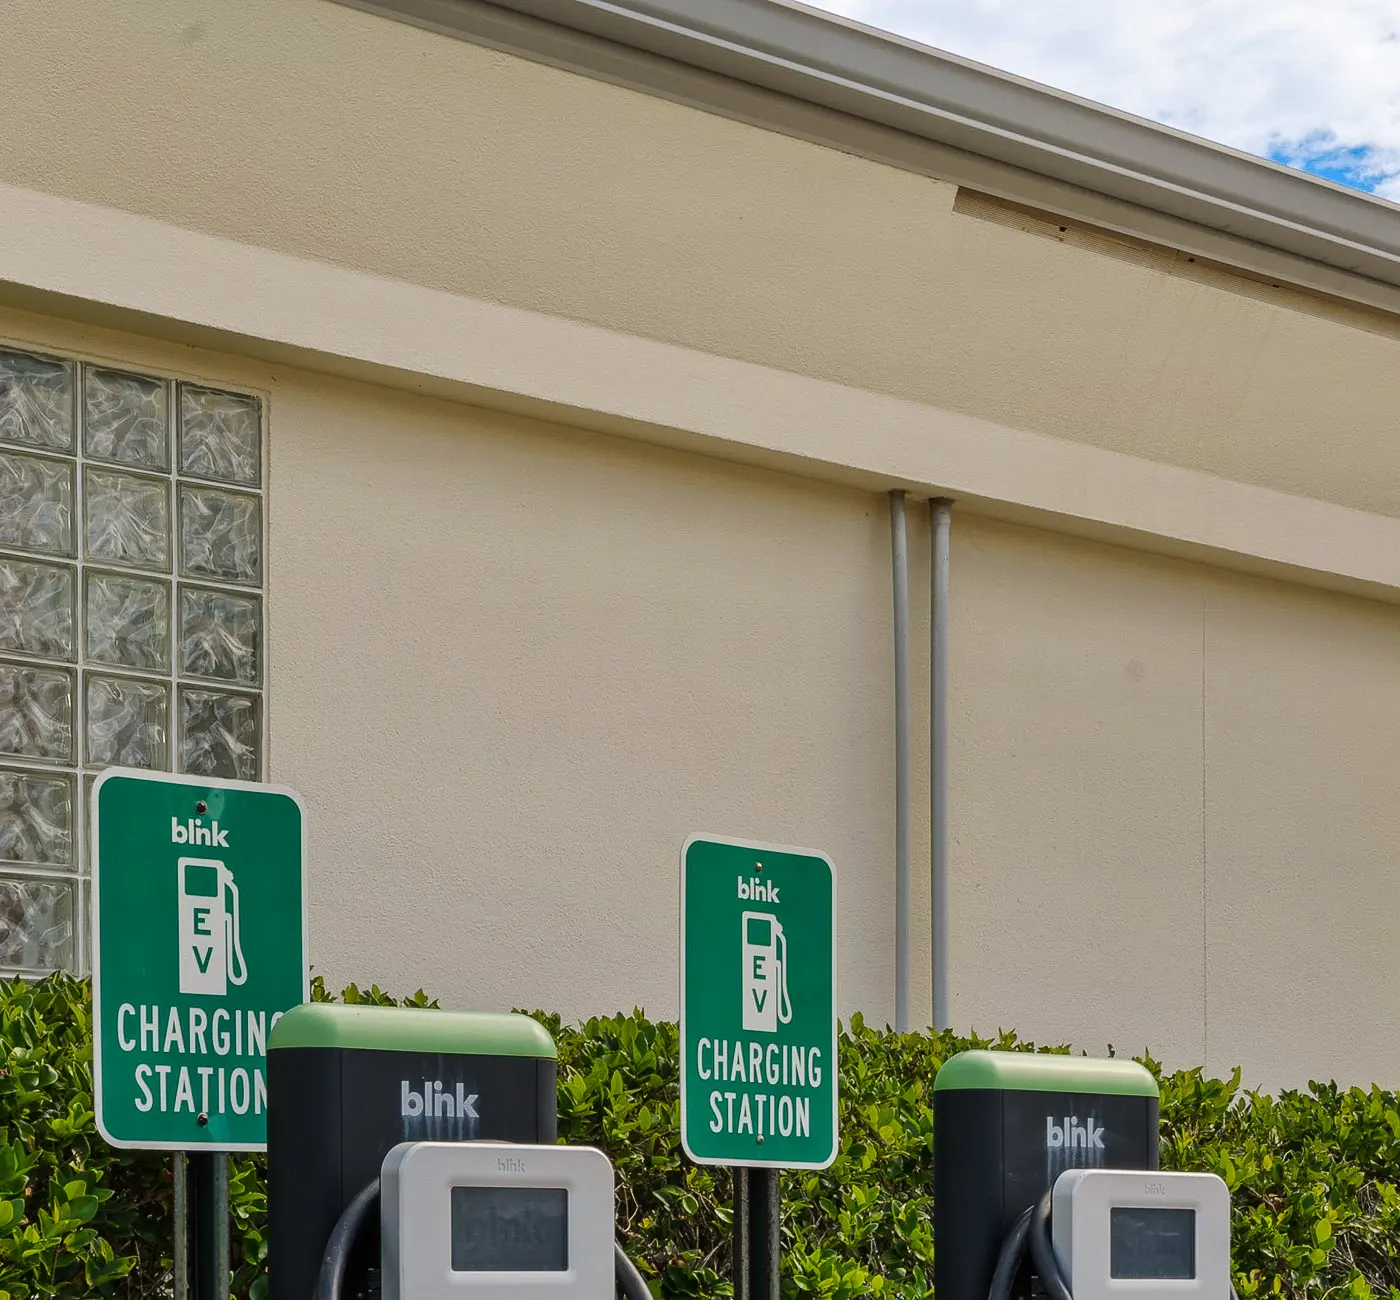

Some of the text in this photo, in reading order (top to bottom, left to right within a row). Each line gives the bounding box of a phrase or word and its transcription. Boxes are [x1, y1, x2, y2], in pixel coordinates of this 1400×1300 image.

[172, 817, 230, 848] blink
[737, 876, 781, 904] blink
[117, 1003, 285, 1057] CHARGIN
[697, 1037, 822, 1088] CHARGING
[401, 1080, 480, 1118] blink
[709, 1091, 810, 1138] STATION
[1046, 1115, 1105, 1148] blink
[497, 1158, 526, 1172] blink
